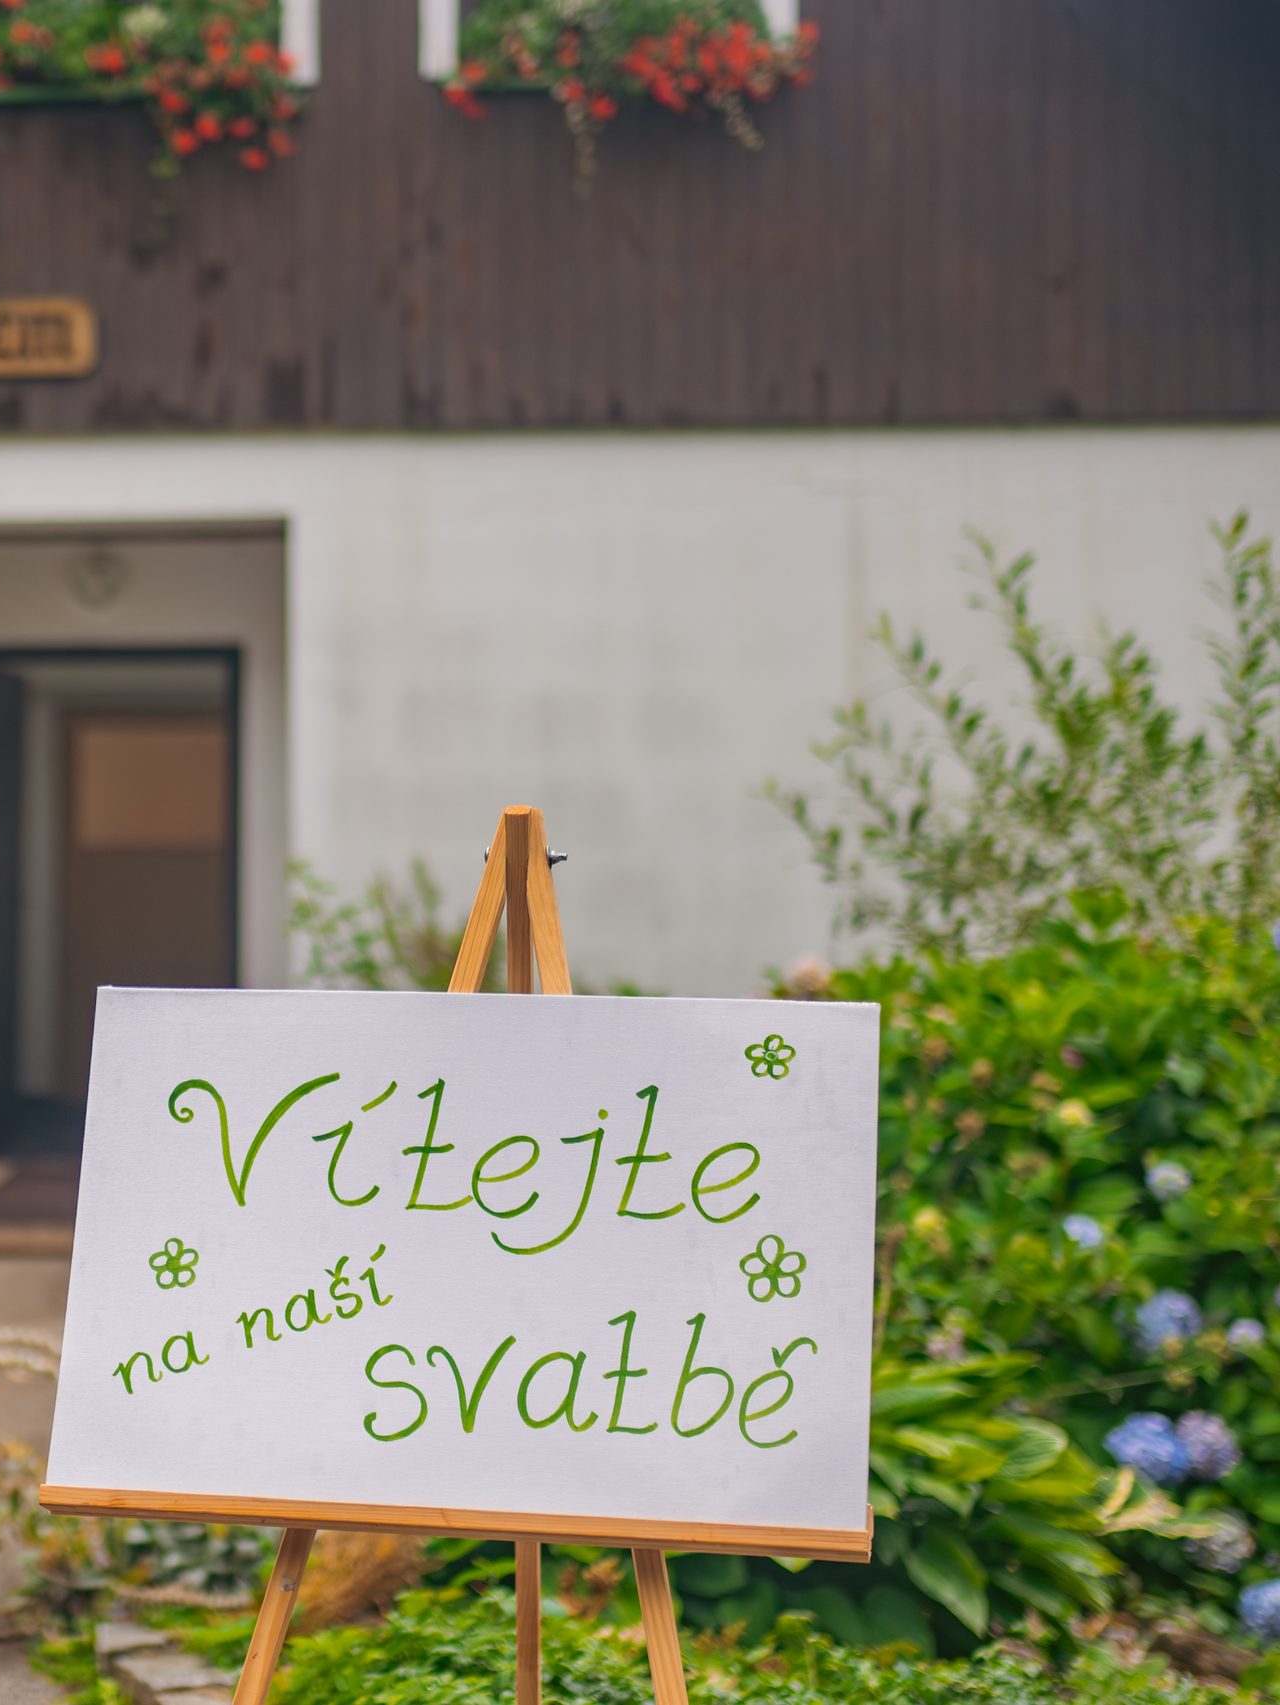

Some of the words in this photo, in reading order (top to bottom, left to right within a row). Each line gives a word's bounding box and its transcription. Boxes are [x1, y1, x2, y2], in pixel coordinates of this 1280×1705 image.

[168, 1072, 761, 1256] Vítejte
[112, 1331, 210, 1395] na
[236, 1243, 394, 1349] naší
[363, 1310, 819, 1449] svatbě
